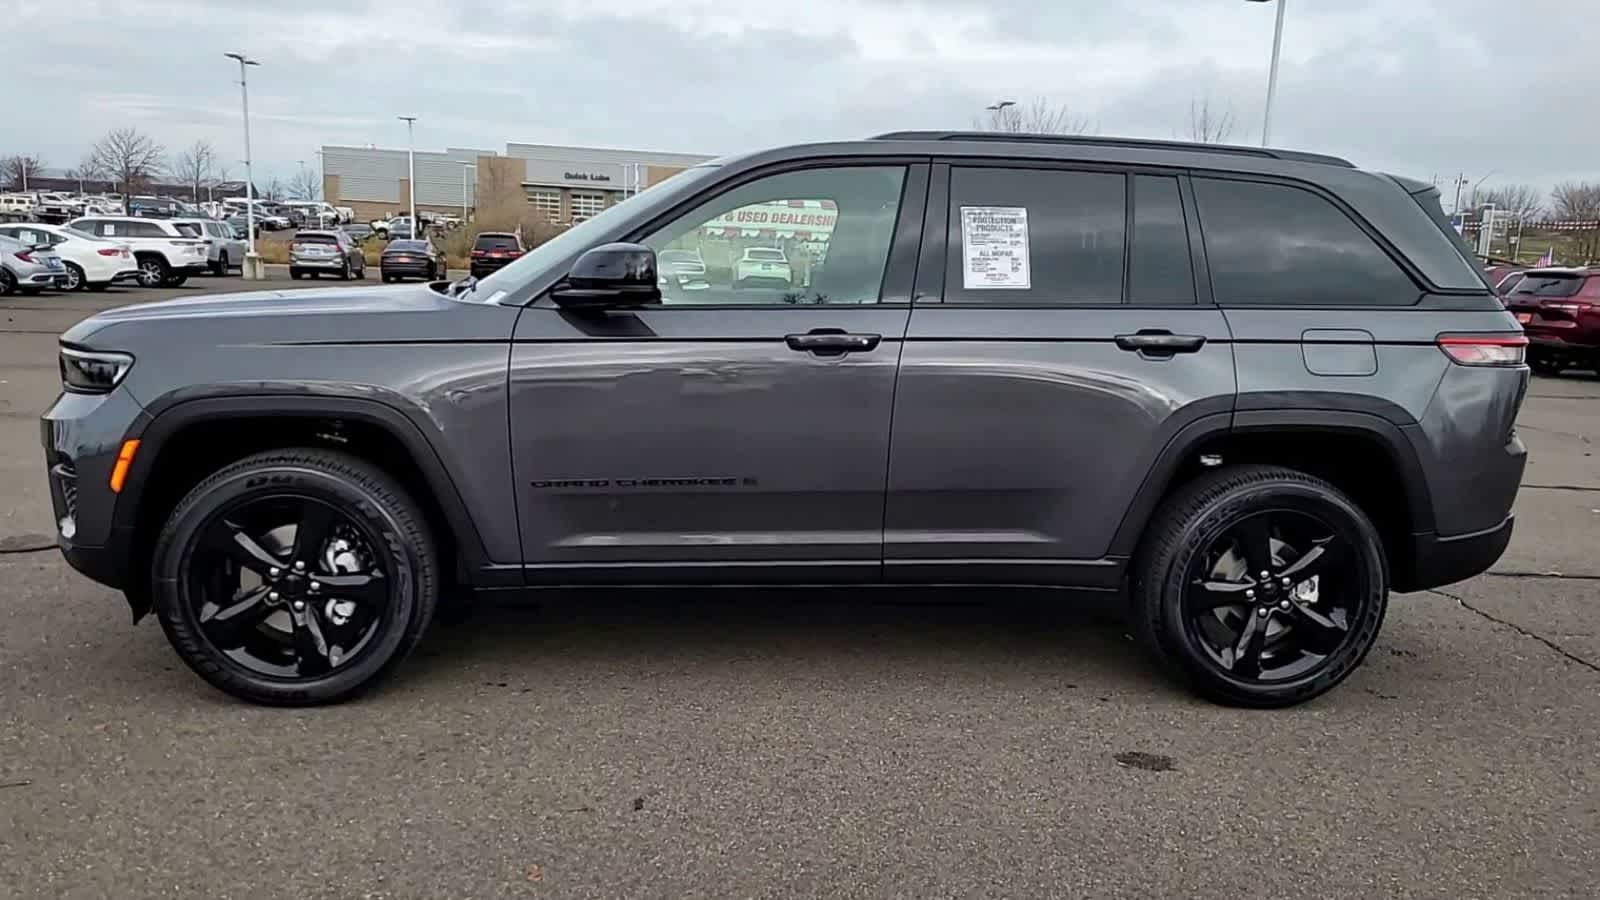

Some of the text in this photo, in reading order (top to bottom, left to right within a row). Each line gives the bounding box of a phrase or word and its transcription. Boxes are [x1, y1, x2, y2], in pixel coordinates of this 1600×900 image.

[564, 172, 611, 181] Quick Lube
[737, 211, 768, 223] USED
[771, 212, 835, 226] DEALERSHI
[972, 216, 1017, 224] PROTECTION
[976, 224, 1014, 232] PRODUCTS
[530, 477, 737, 488] GRAND CHEROKEE
